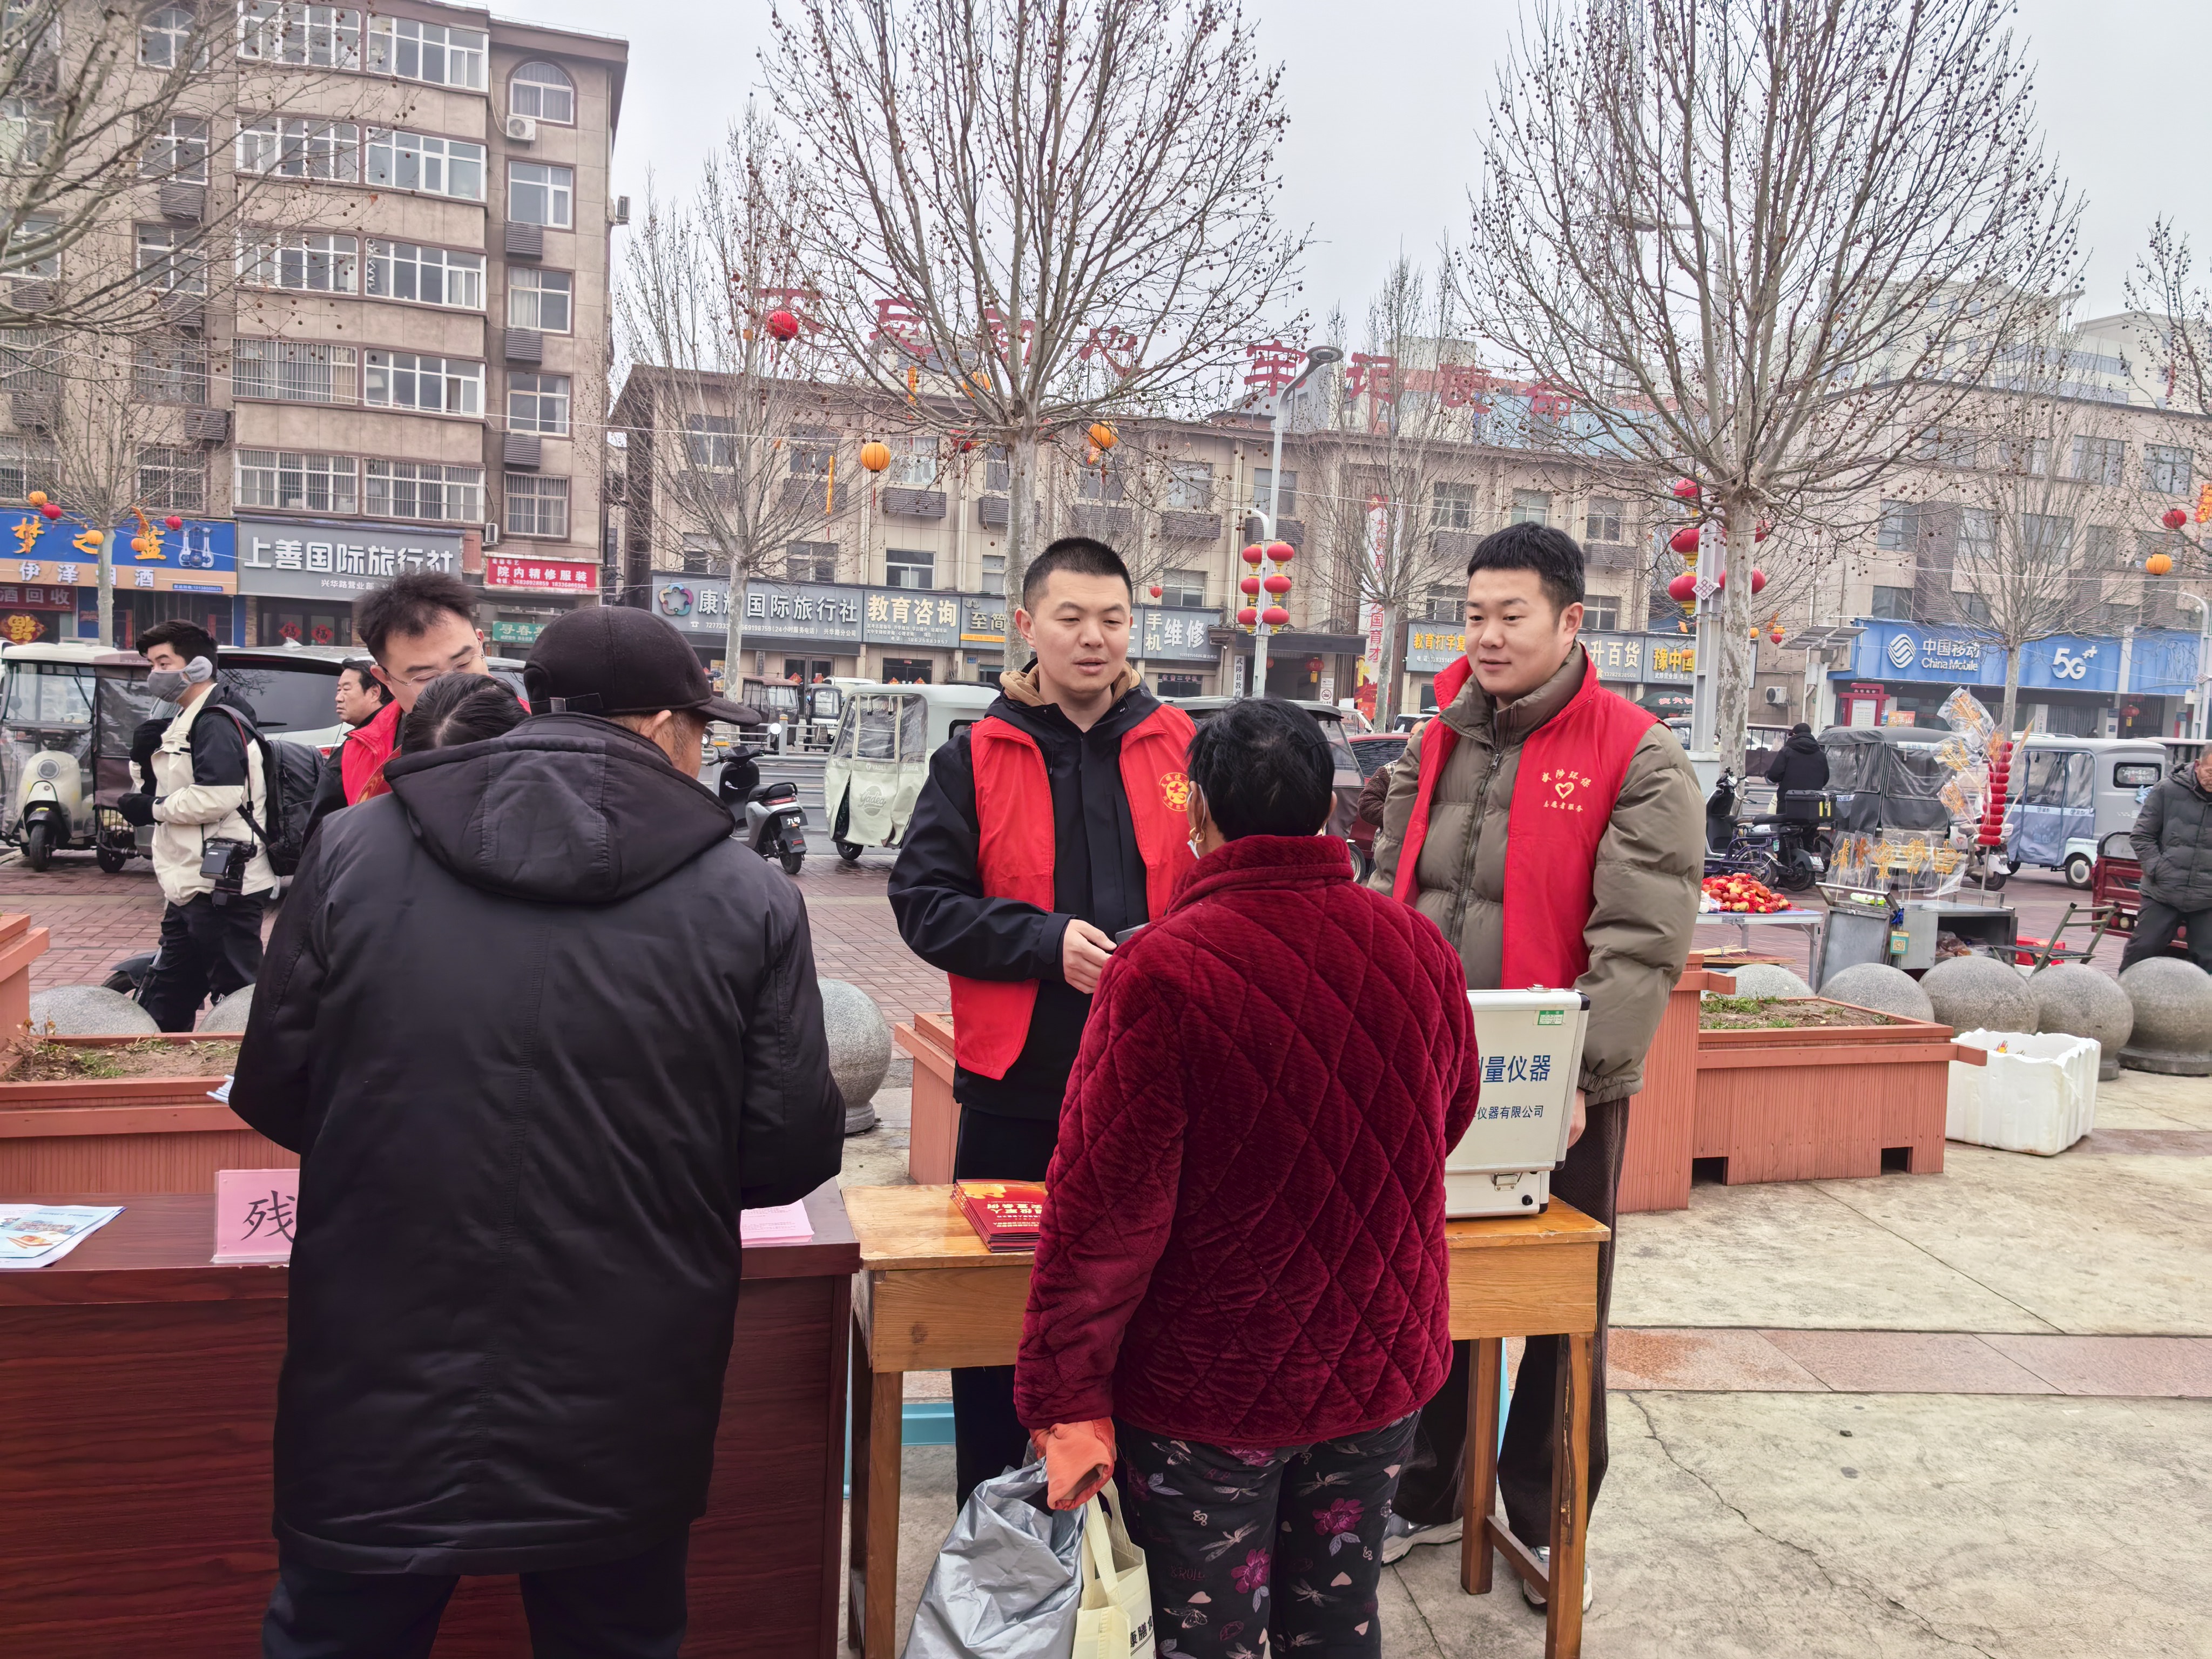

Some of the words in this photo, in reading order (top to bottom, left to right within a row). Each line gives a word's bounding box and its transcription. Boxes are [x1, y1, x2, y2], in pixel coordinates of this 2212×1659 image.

[244, 537, 453, 576] 上善国际旅行社
[497, 566, 587, 582] 院内精修服装
[321, 579, 374, 590] 兴华路营业部
[0, 586, 70, 605] 酒回收
[868, 595, 957, 628] 教育咨询
[740, 624, 818, 635] 569198759(24小时服务电话)
[824, 629, 857, 637] 兴华路分公司
[1145, 613, 1163, 651] 手机
[1164, 618, 1205, 648] 维修
[1579, 639, 1640, 668] 升百货
[1922, 638, 1980, 658] 中国移动
[1921, 657, 1947, 669] China
[1948, 659, 1978, 672] Mobile
[1479, 1055, 1551, 1083] 量仪器
[1474, 1105, 1543, 1120] 仪器有限公司
[240, 1190, 296, 1243] 残
